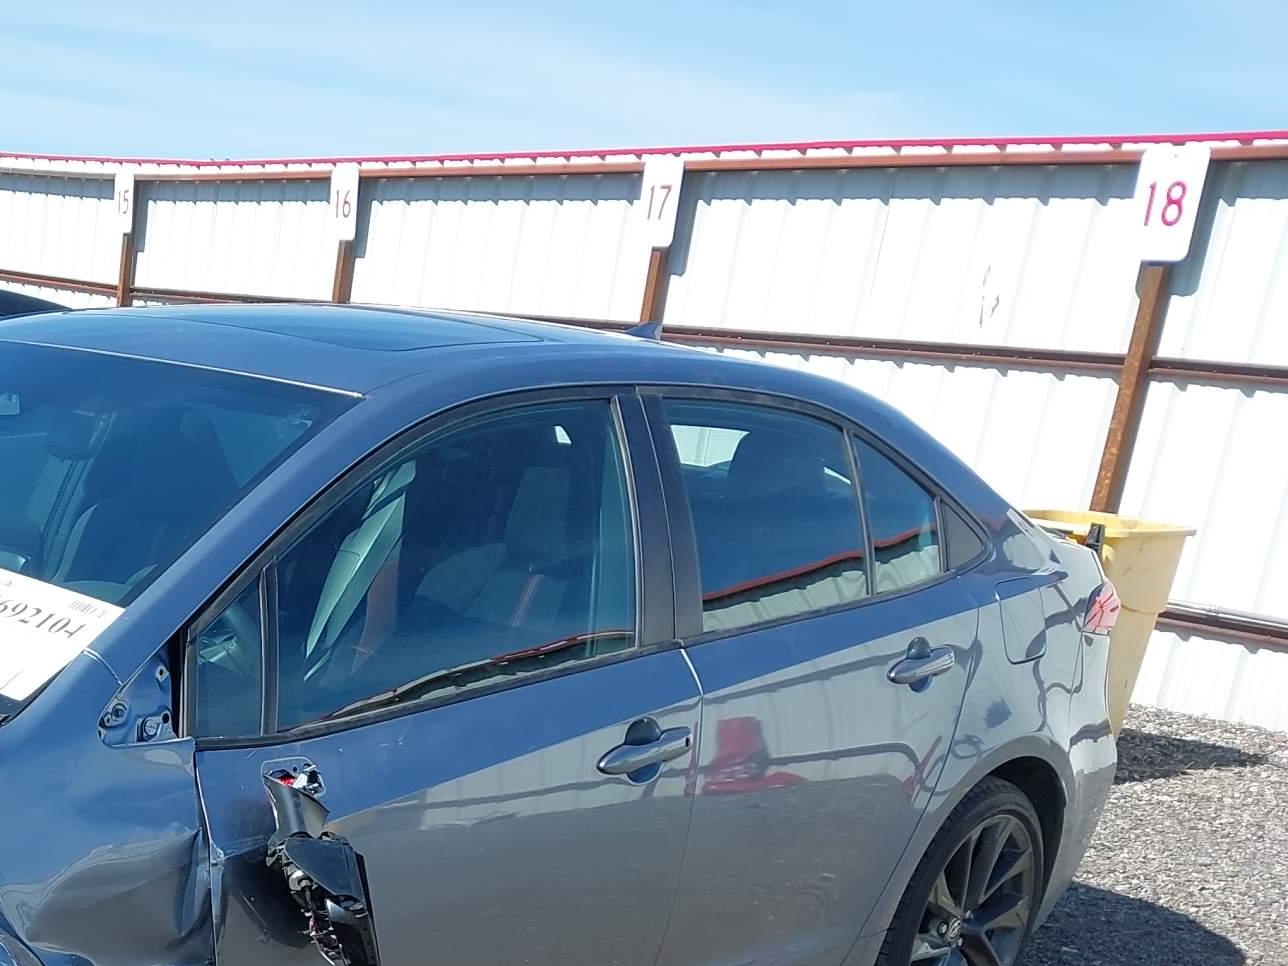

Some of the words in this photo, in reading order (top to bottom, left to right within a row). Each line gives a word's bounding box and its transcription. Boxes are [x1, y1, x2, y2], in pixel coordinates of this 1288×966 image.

[118, 189, 129, 215] 15
[335, 189, 351, 218] 16
[647, 184, 672, 220] 17
[1144, 181, 1187, 226] 18
